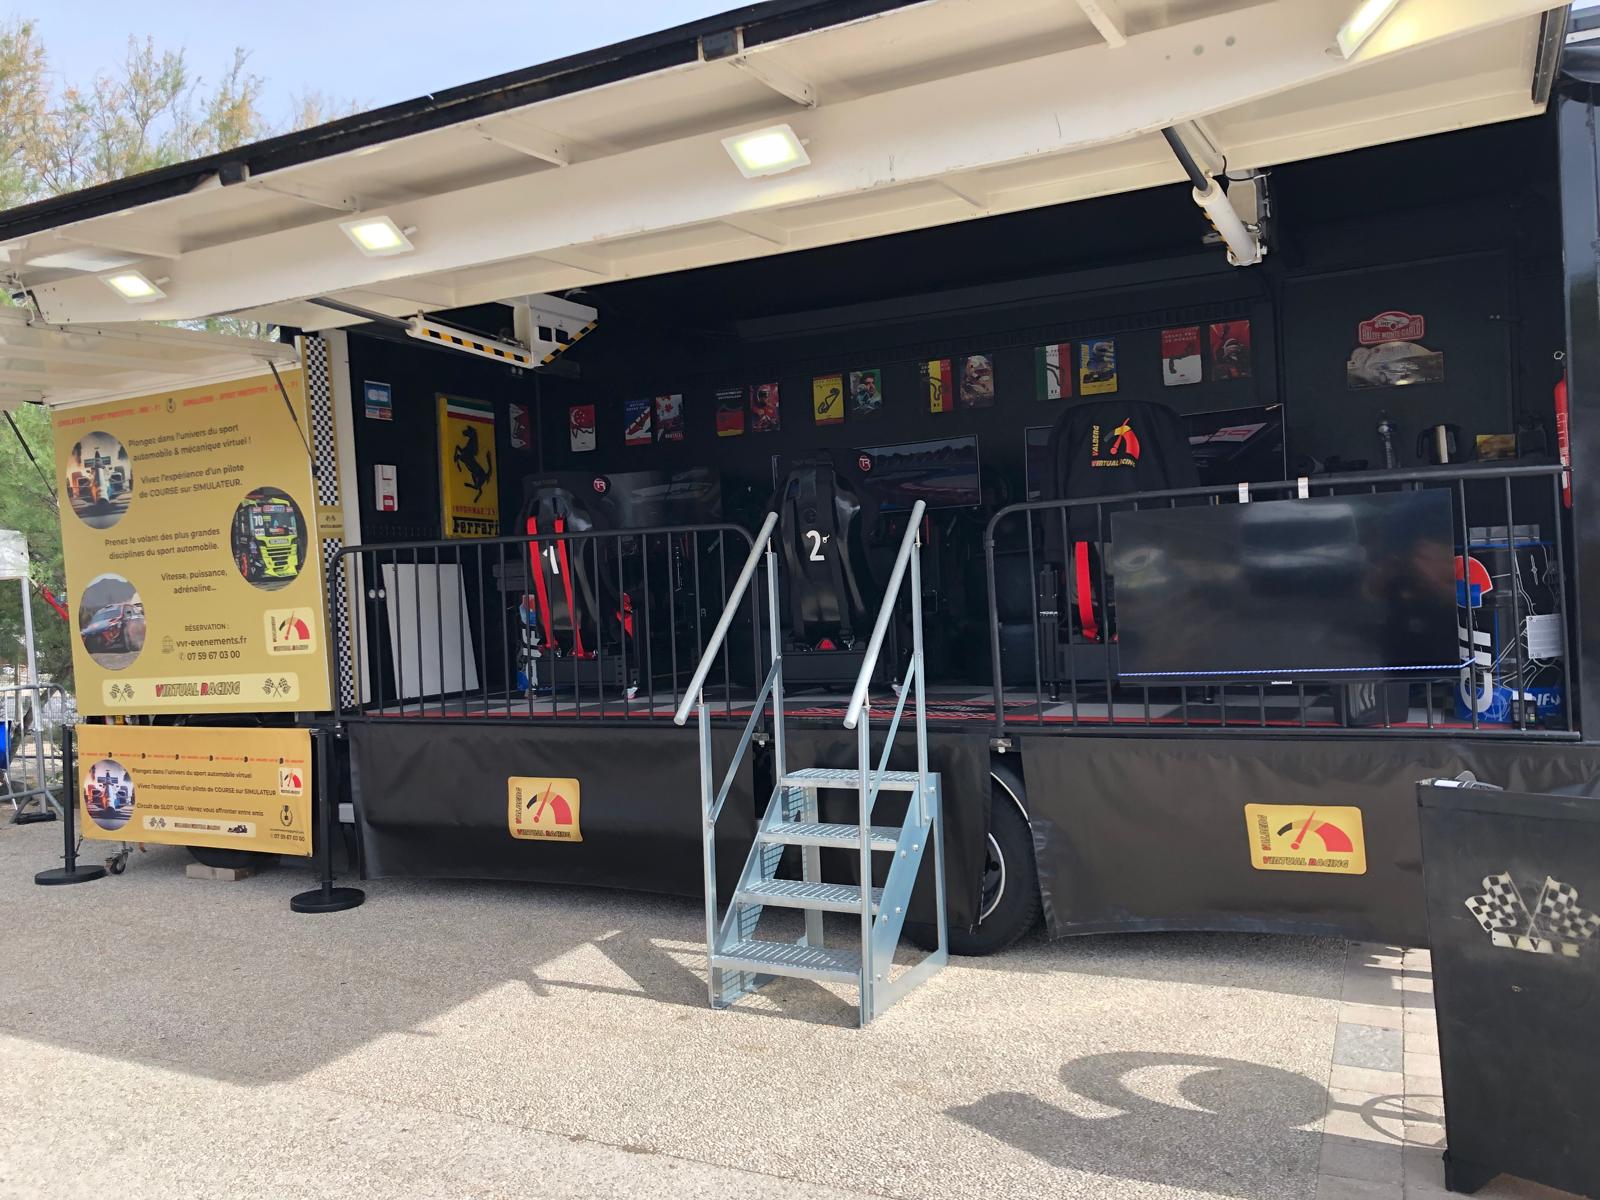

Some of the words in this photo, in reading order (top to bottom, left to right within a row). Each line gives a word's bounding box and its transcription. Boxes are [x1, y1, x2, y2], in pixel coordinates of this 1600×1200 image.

[129, 438, 156, 448] Plongez
[158, 434, 175, 444] dans
[176, 430, 206, 440] l'univers
[208, 427, 218, 436] du
[219, 424, 239, 434] sport
[133, 448, 173, 461] automobile
[174, 448, 179, 456] &
[181, 442, 221, 454] mécanique
[223, 437, 247, 448] virtuel
[141, 475, 160, 484] Vivez
[161, 470, 204, 481] l'expérience
[205, 467, 222, 476] d'un
[223, 464, 244, 475] pilote
[139, 490, 148, 499] de
[149, 487, 179, 497] COURSE
[193, 478, 243, 492] SIMULATEUR.
[453, 517, 501, 536] Ferrari
[105, 538, 128, 546] Prenez
[129, 537, 136, 545] le
[137, 534, 159, 543] volant
[160, 532, 173, 541] des
[174, 531, 190, 541] plus
[190, 528, 220, 540] grandes
[806, 530, 825, 561] 2
[109, 550, 145, 560] disciplines
[146, 548, 156, 557] du
[156, 547, 176, 556] sport
[176, 542, 220, 553] automobile.
[190, 568, 228, 580] puissance,
[184, 623, 226, 632] RÉSERVATION
[176, 635, 247, 647] vvr-evenements.fr
[187, 652, 196, 661] 07
[198, 651, 207, 660] 59
[208, 651, 218, 660] 67
[219, 650, 229, 659] 03
[230, 650, 241, 659] 00
[155, 682, 200, 697] VIRTUAL
[200, 681, 241, 696] RACING
[245, 788, 276, 796] SIMULATEUR
[1262, 855, 1307, 866] VIRTUAL
[1308, 857, 1349, 869] RACING
